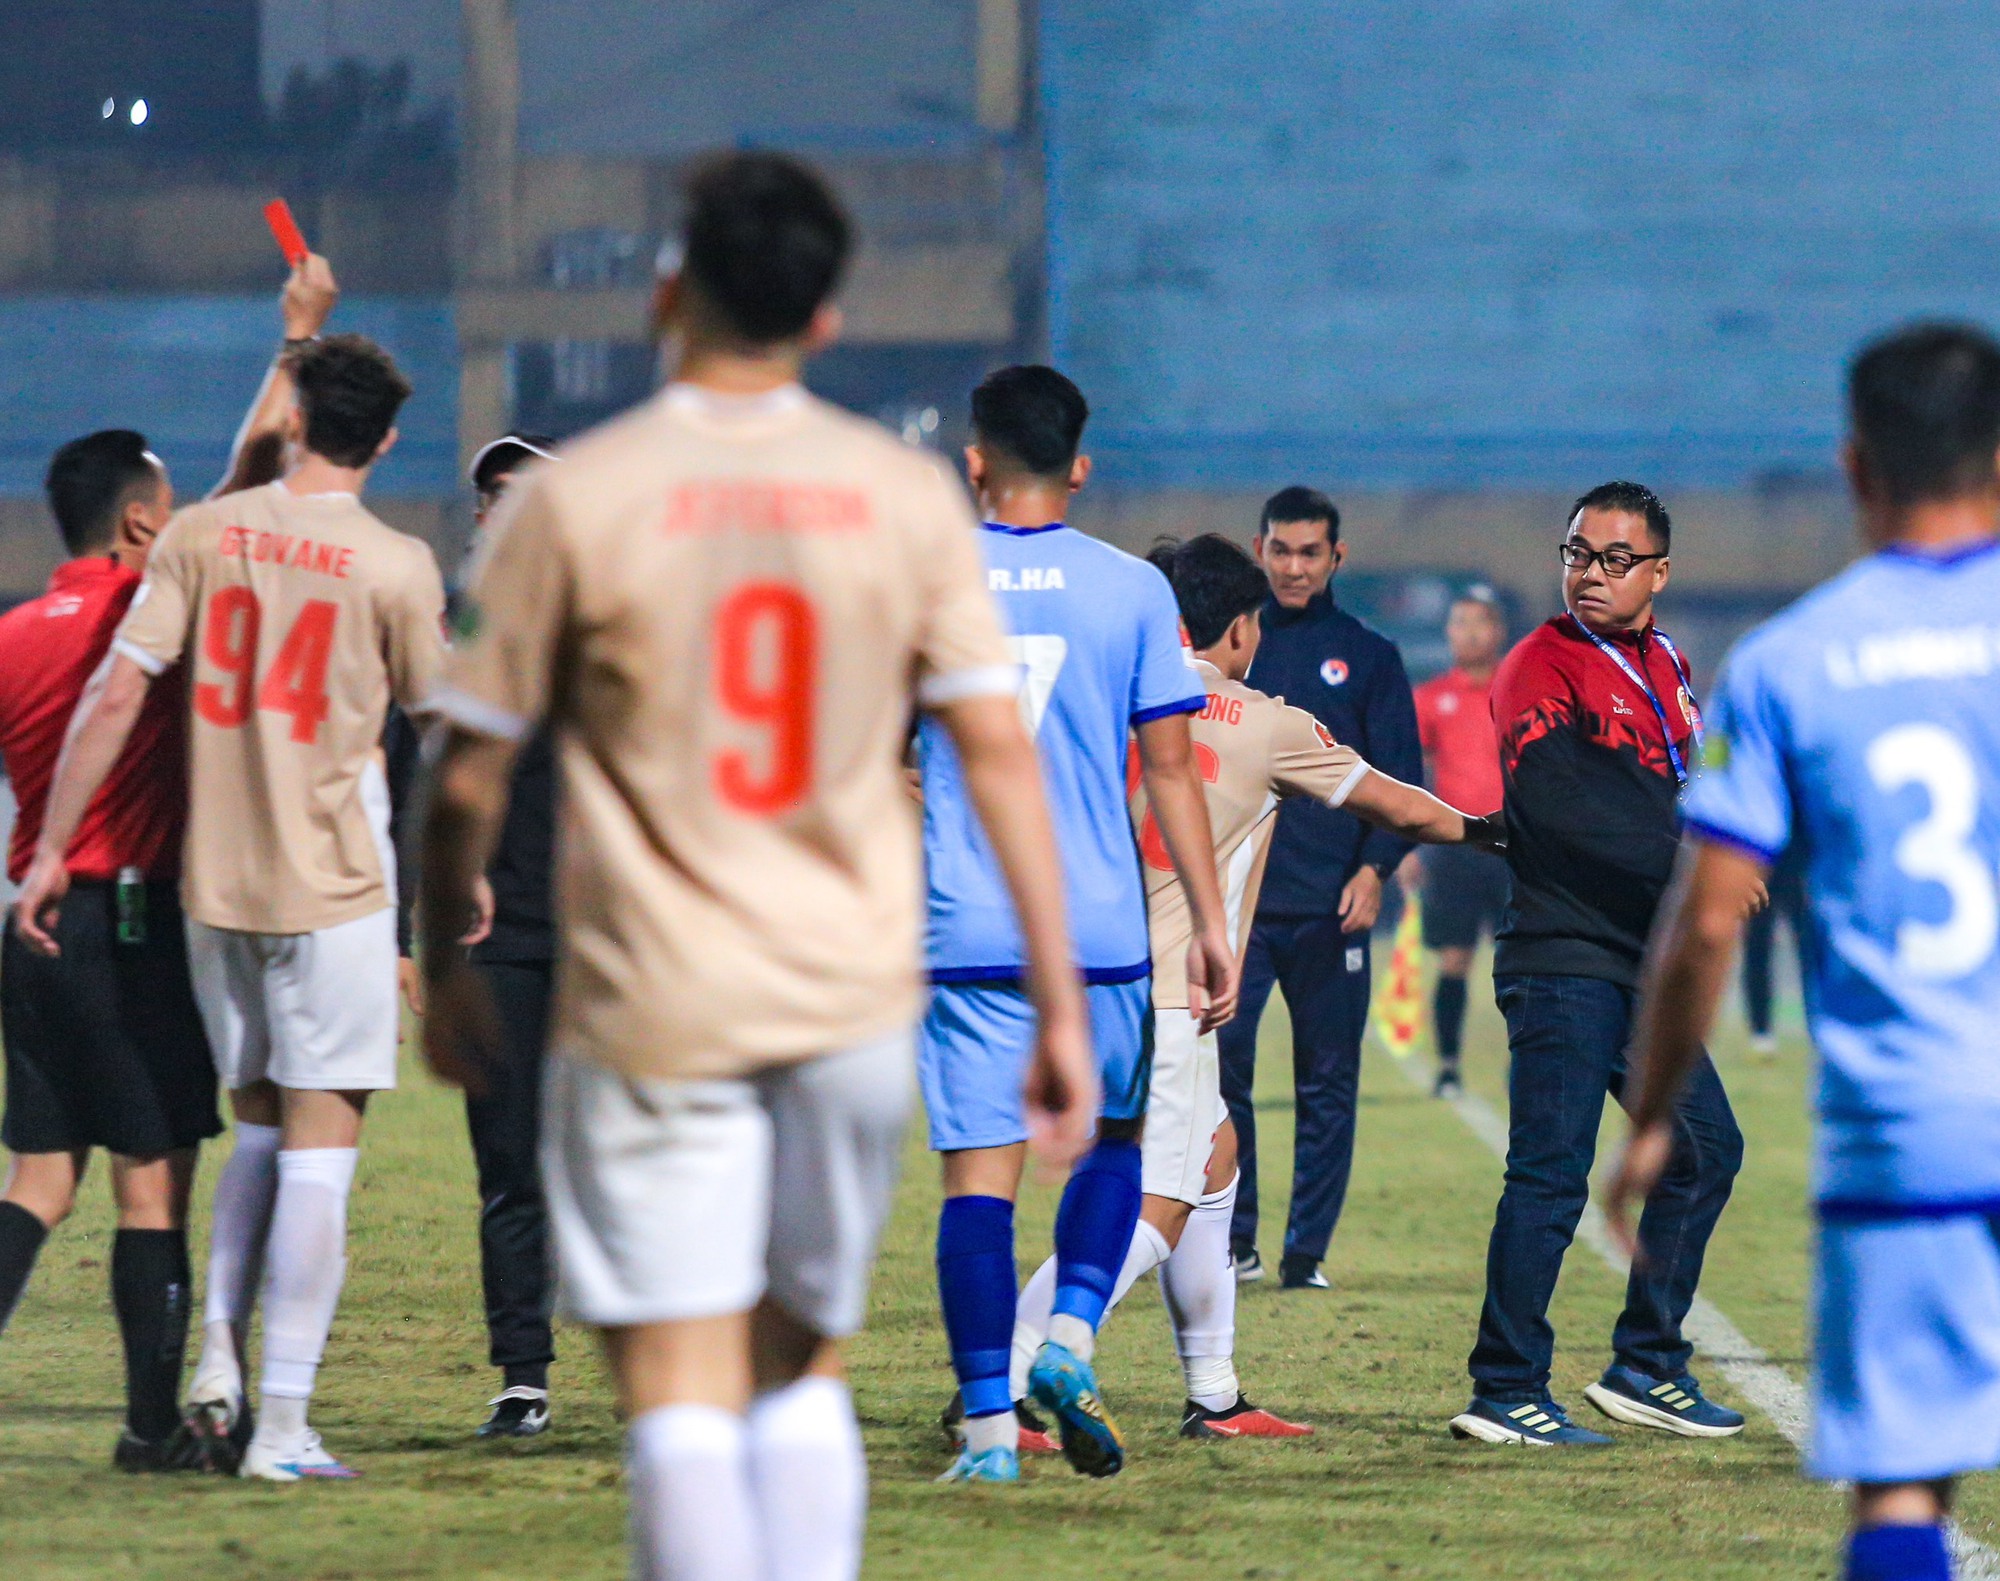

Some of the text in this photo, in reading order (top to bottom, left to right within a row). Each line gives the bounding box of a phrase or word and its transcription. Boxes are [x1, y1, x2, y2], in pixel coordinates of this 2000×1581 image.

[192, 583, 339, 746] 94
[713, 580, 818, 817] 9
[1866, 722, 1997, 982] 3
